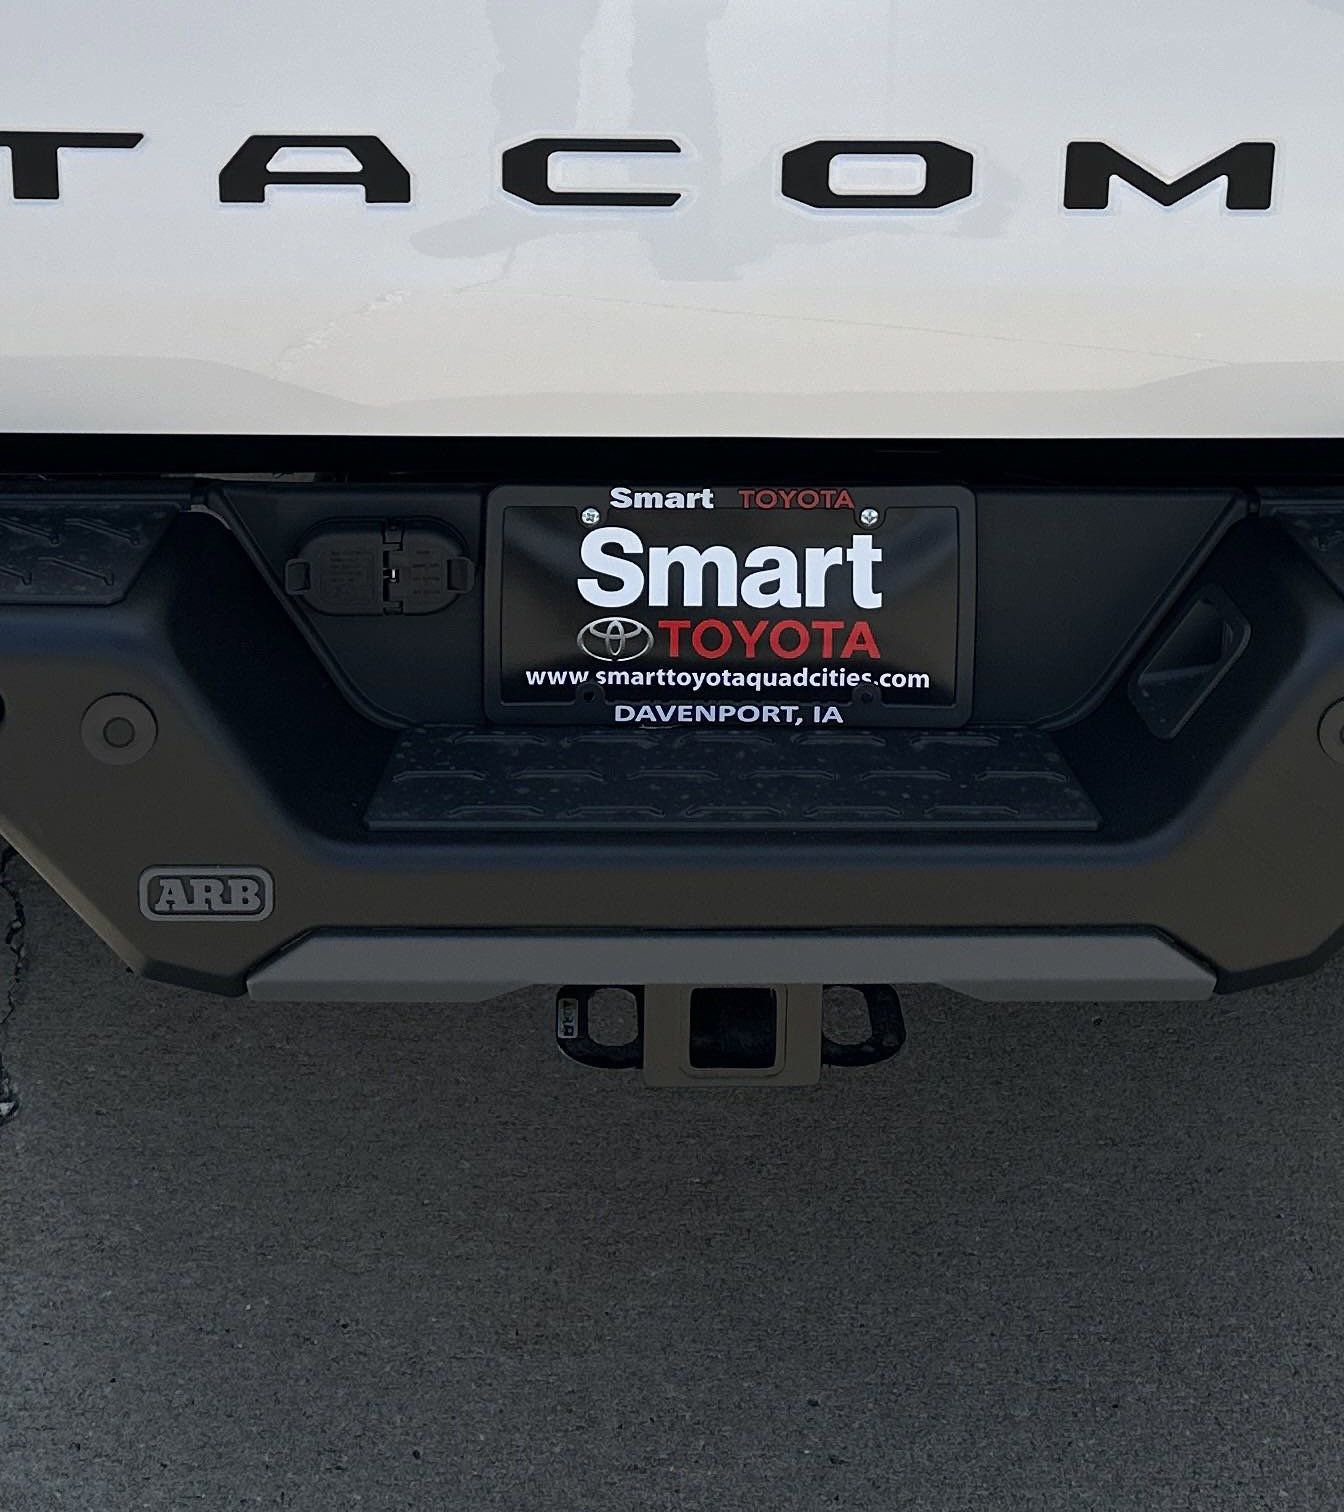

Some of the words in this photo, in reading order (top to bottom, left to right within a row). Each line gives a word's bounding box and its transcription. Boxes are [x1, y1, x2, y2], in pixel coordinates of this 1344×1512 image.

[609, 487, 715, 509] Smart
[738, 489, 855, 509] TOYOTA
[577, 526, 883, 609] Smart
[657, 619, 882, 660] TOYOTA
[525, 667, 931, 692] wwwsmarttoyotaquadcities.com
[614, 704, 804, 726] DAVENPORT,
[813, 705, 844, 724] IA
[155, 877, 262, 912] ARB
